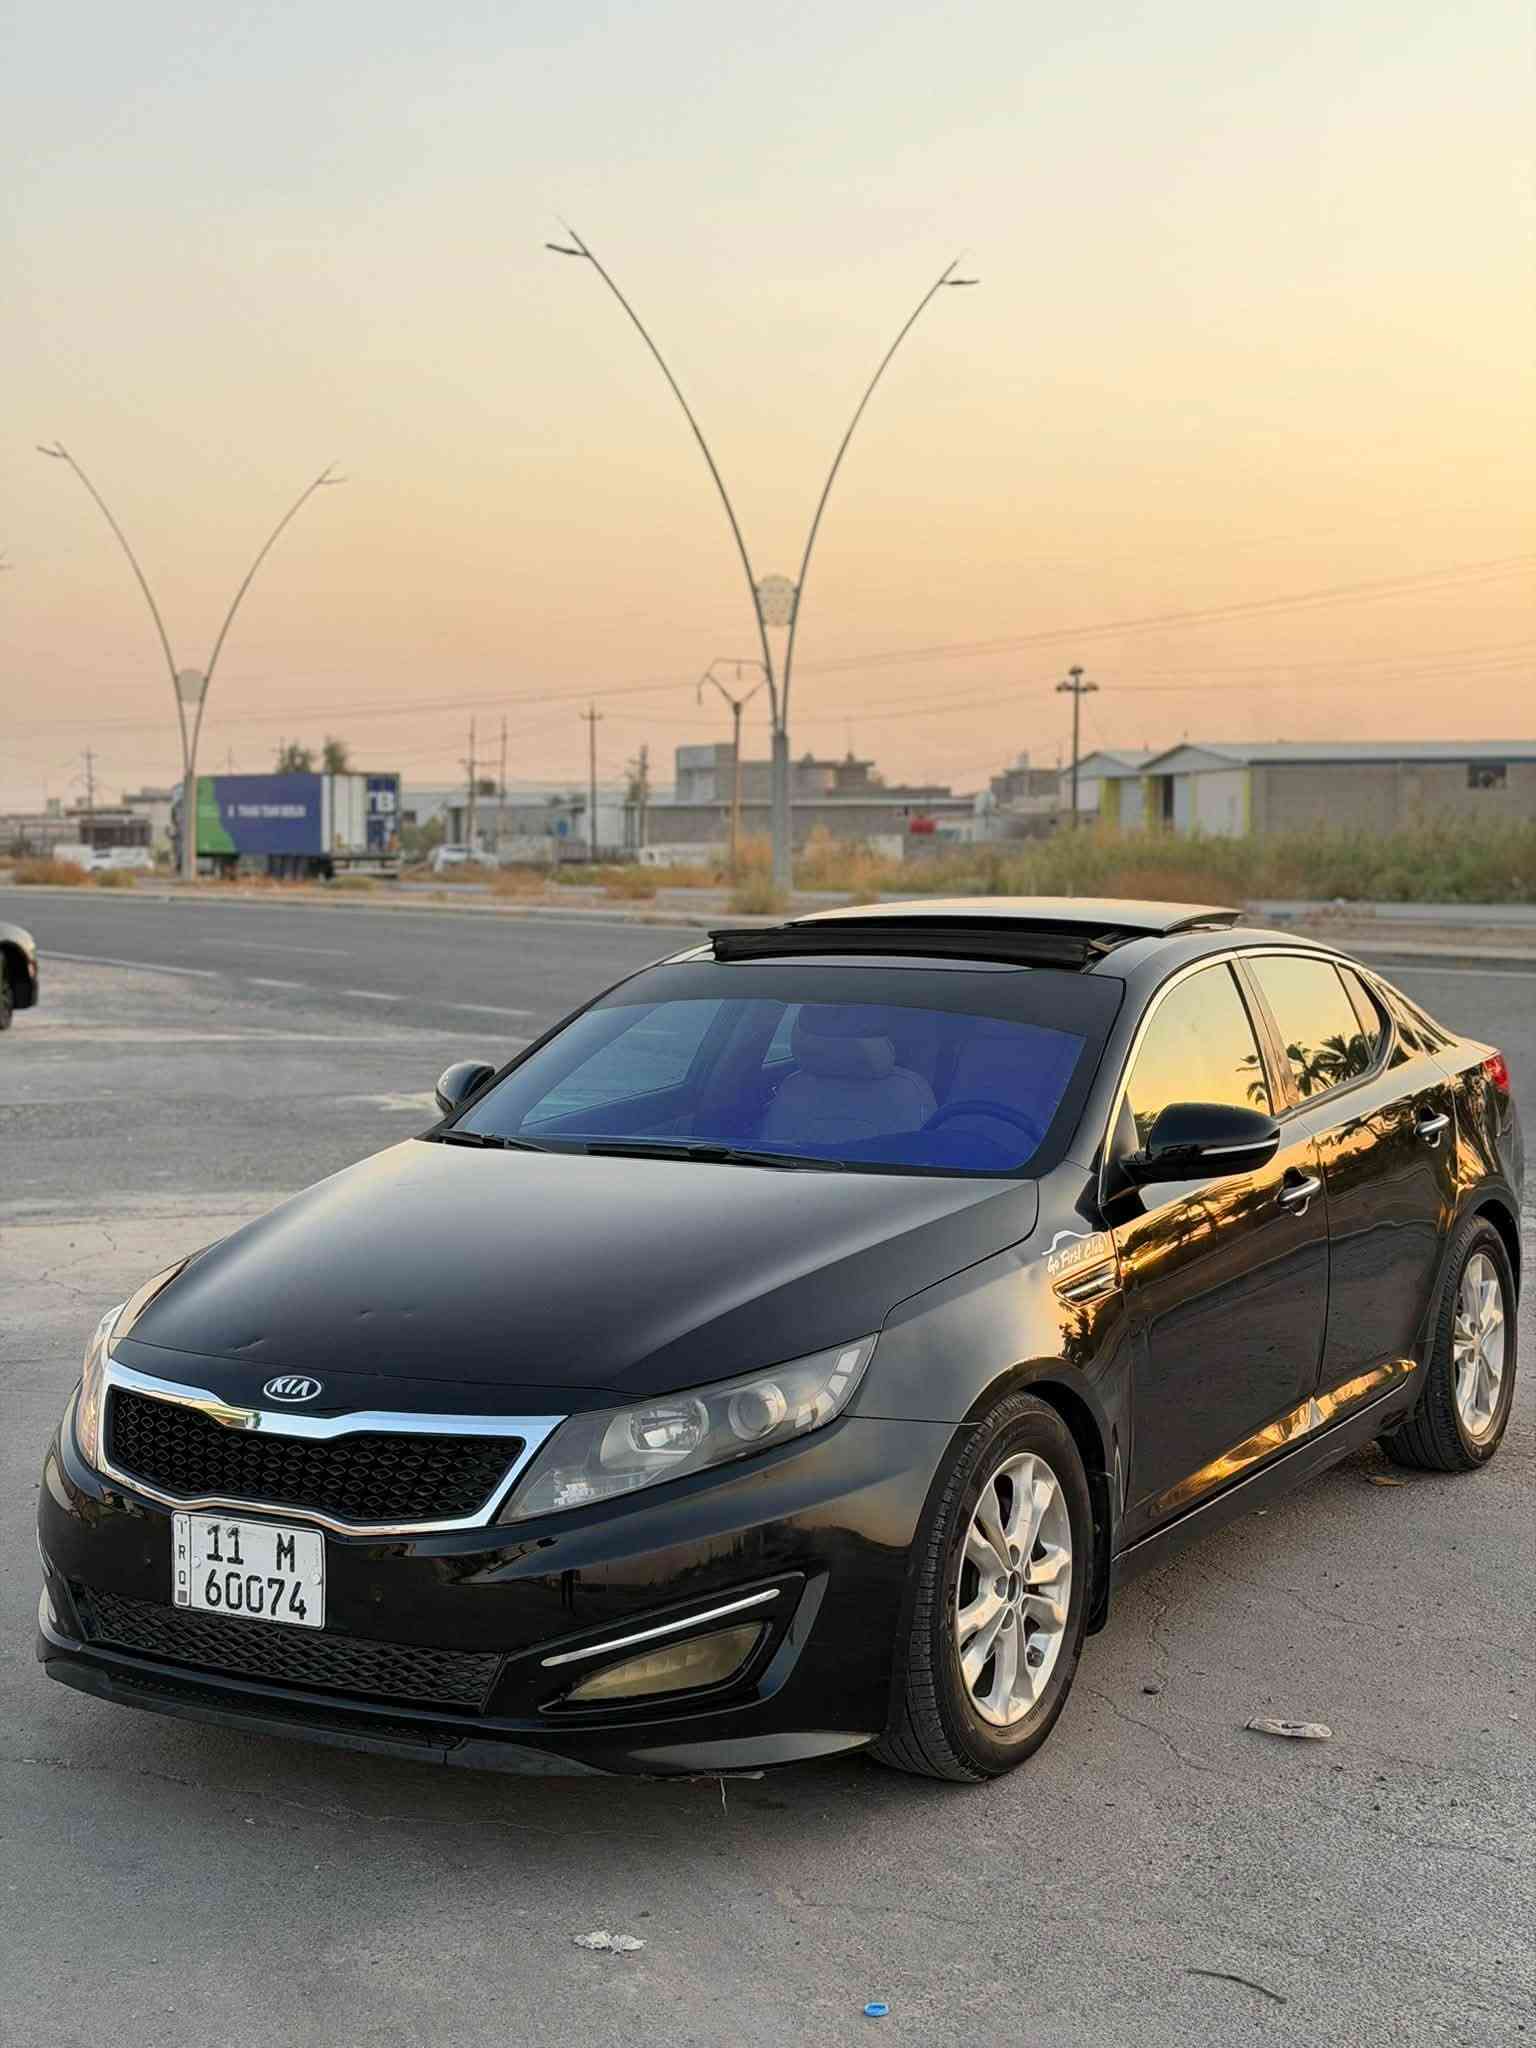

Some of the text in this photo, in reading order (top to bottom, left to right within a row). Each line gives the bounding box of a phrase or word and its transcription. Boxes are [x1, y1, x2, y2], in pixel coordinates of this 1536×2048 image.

[269, 1378, 311, 1397] KIA
[206, 1524, 295, 1572] 11 M
[205, 1569, 307, 1620] 60074
